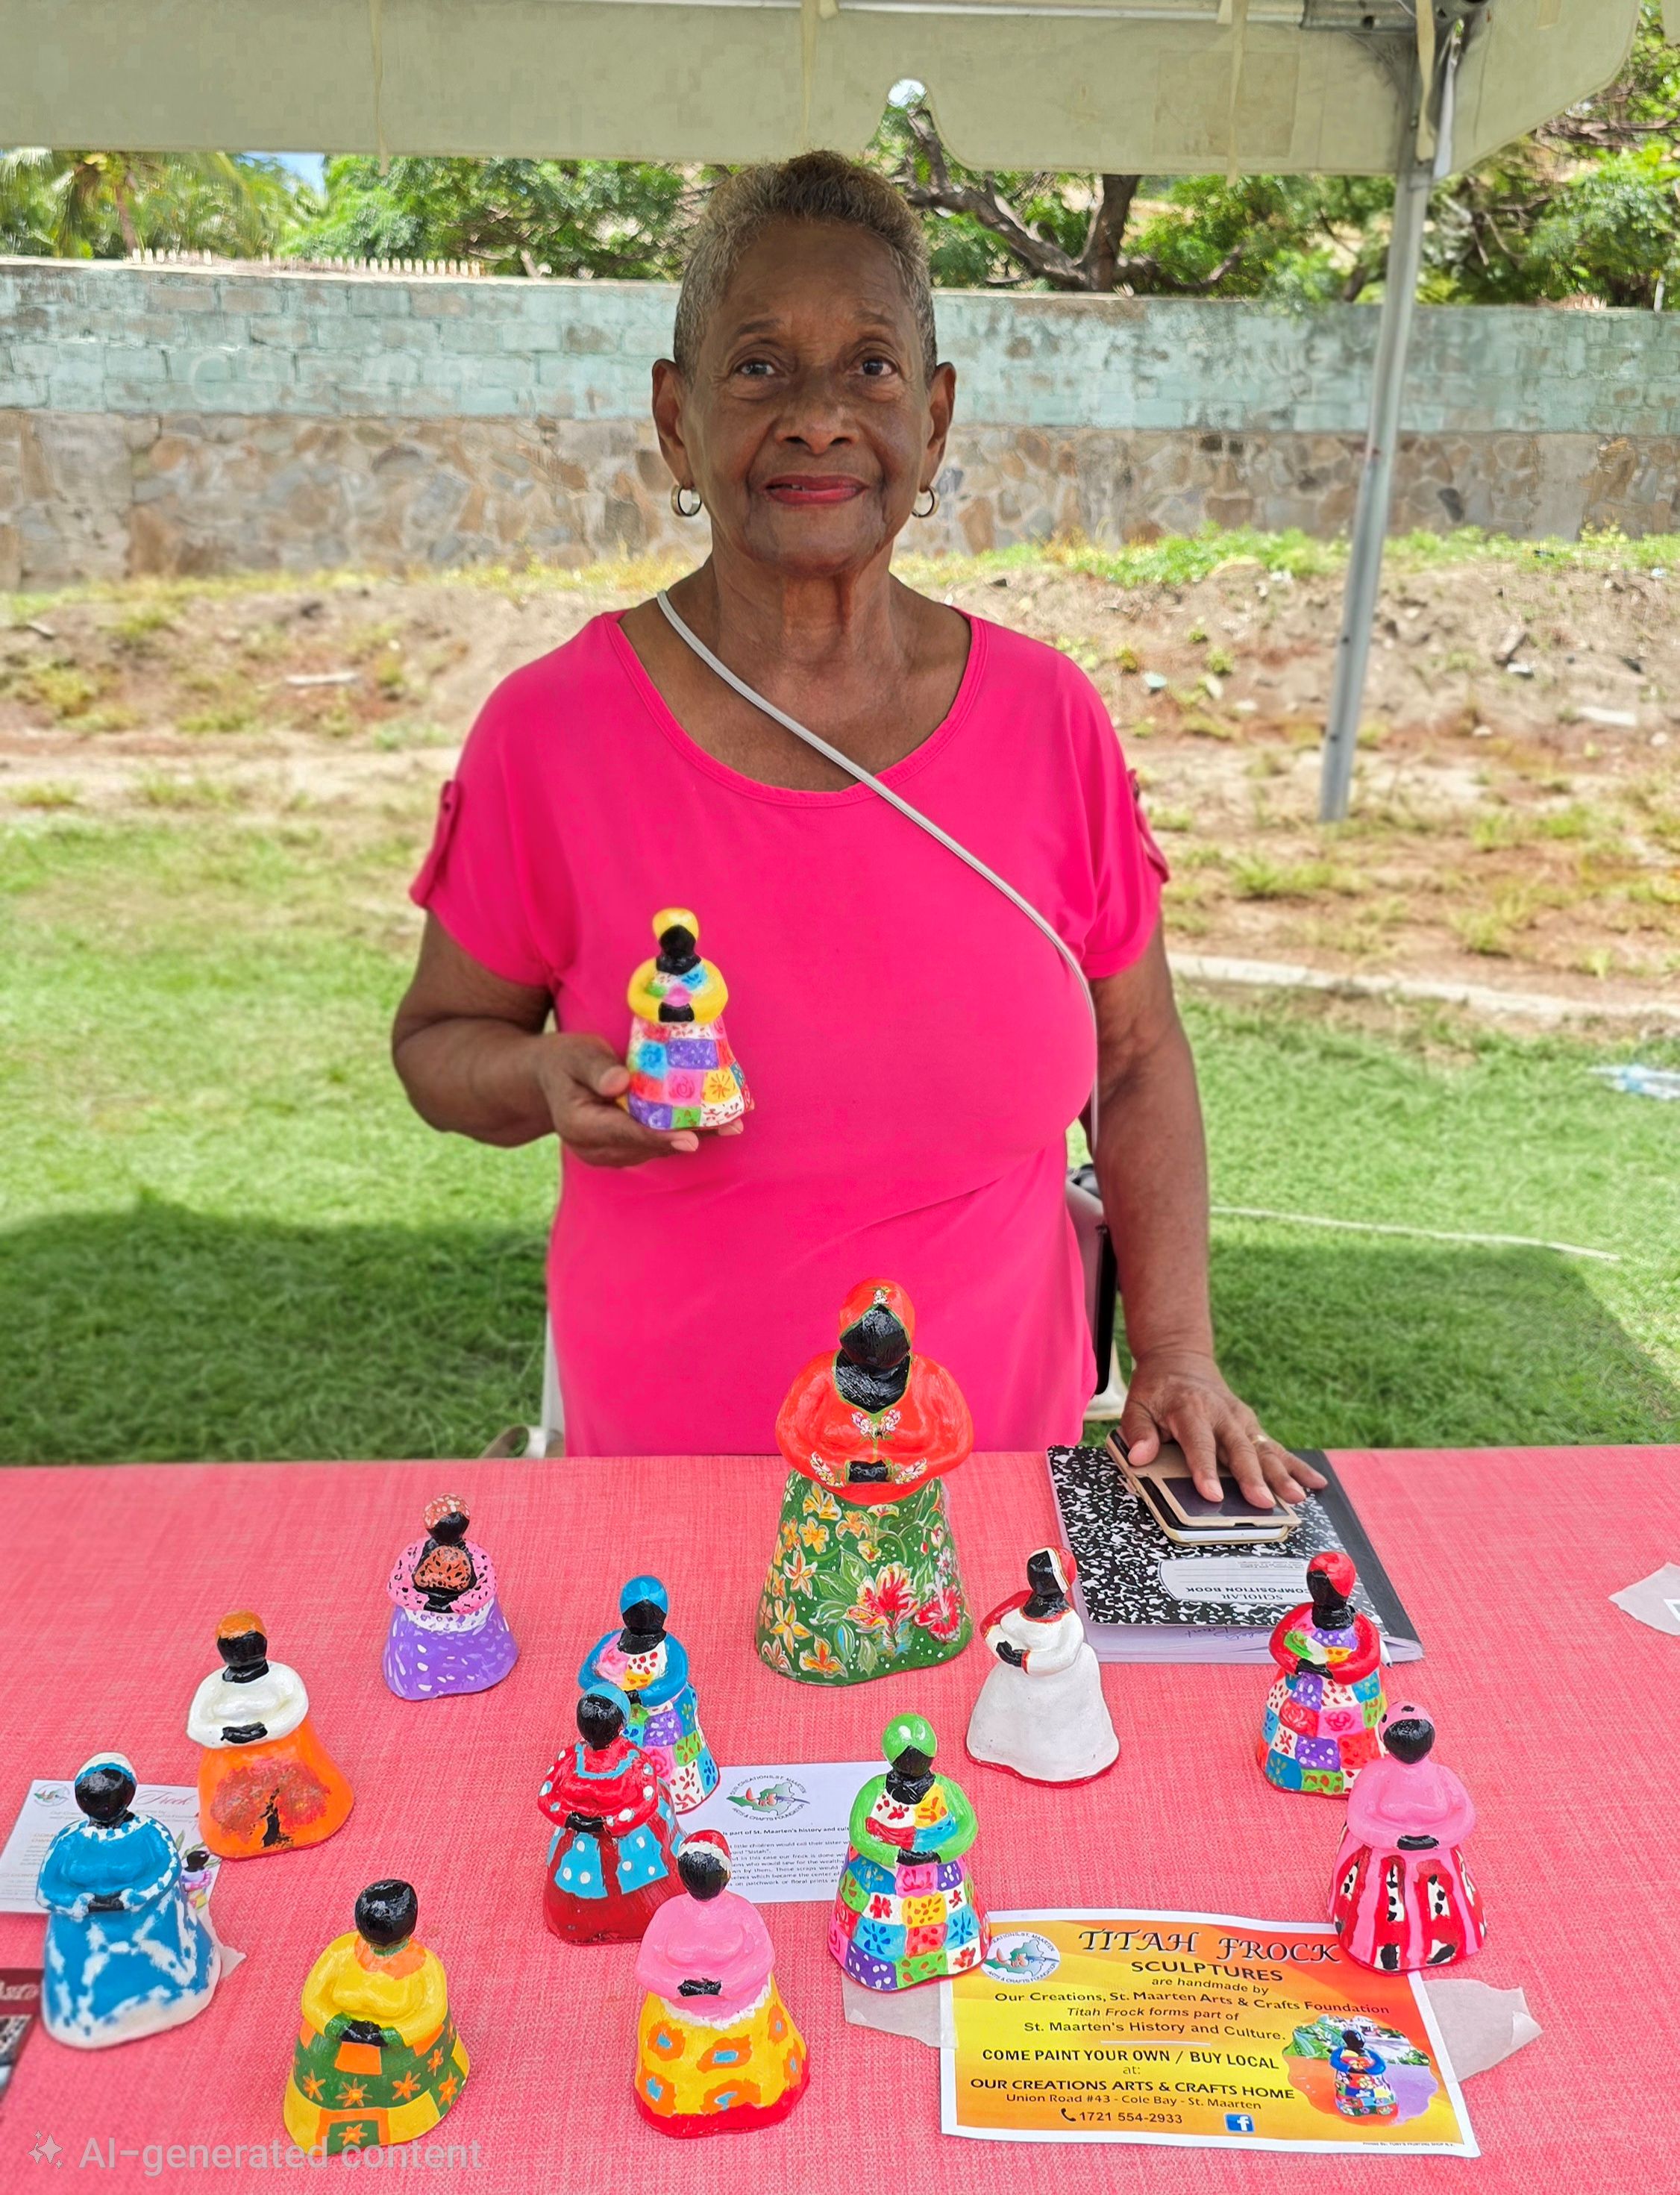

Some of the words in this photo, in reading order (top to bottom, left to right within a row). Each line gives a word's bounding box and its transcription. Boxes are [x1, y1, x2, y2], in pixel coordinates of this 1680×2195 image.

[1078, 1928, 1200, 1952] TITAH
[1216, 1937, 1341, 1962] FROCK
[1131, 1961, 1283, 1982] SCULPTURES
[1152, 1978, 1173, 1986] are
[1177, 1979, 1248, 1992] handmade
[1253, 1985, 1269, 1996] by
[994, 1993, 1024, 2001] Our
[1029, 1992, 1106, 2002] Creations,
[1109, 1992, 1129, 2001] St.
[1133, 1991, 1196, 2001] Maarten
[1200, 1994, 1232, 2005] Arts
[1238, 1998, 1249, 2006] &
[1254, 2000, 1300, 2010] Crafts
[1305, 2001, 1390, 2014] Foundation
[1068, 2007, 1100, 2016] Titah
[1106, 2007, 1144, 2016] Frock
[1149, 2007, 1189, 2017] forms
[1194, 2010, 1225, 2020] part
[1226, 2012, 1240, 2021] of
[1024, 2022, 1044, 2032] St.
[1050, 2022, 1124, 2032] Maarten's
[1129, 2022, 1185, 2034] History
[1191, 2025, 1219, 2035] and
[1224, 2026, 1285, 2040] Culture.
[982, 2049, 1030, 2061] COME
[1035, 2050, 1079, 2061] PAINT
[1085, 2050, 1129, 2061] YOUR
[1132, 2050, 1170, 2061] OWN
[1175, 2050, 1183, 2064] /
[1190, 2051, 1222, 2064] BUY
[1226, 2053, 1279, 2070] LOCAL
[1123, 2066, 1141, 2075] at:
[971, 2079, 1007, 2089] OUR
[1012, 2080, 1107, 2091] CREATIONS
[1112, 2081, 1153, 2091] ARTS
[1159, 2082, 1170, 2091] &
[1174, 2082, 1238, 2095] CRAFTS
[1242, 2088, 1295, 2100] HOME
[1006, 2094, 1045, 2102] Union
[1050, 2094, 1082, 2103] Road
[1086, 2094, 1110, 2103] #43
[1122, 2095, 1150, 2104] Cole
[1153, 2096, 1177, 2107] Bay
[1188, 2097, 1203, 2106] St.
[1207, 2098, 1261, 2110] Maarten
[1079, 2112, 1112, 2121] 1721
[1118, 2112, 1182, 2124] 554-2933
